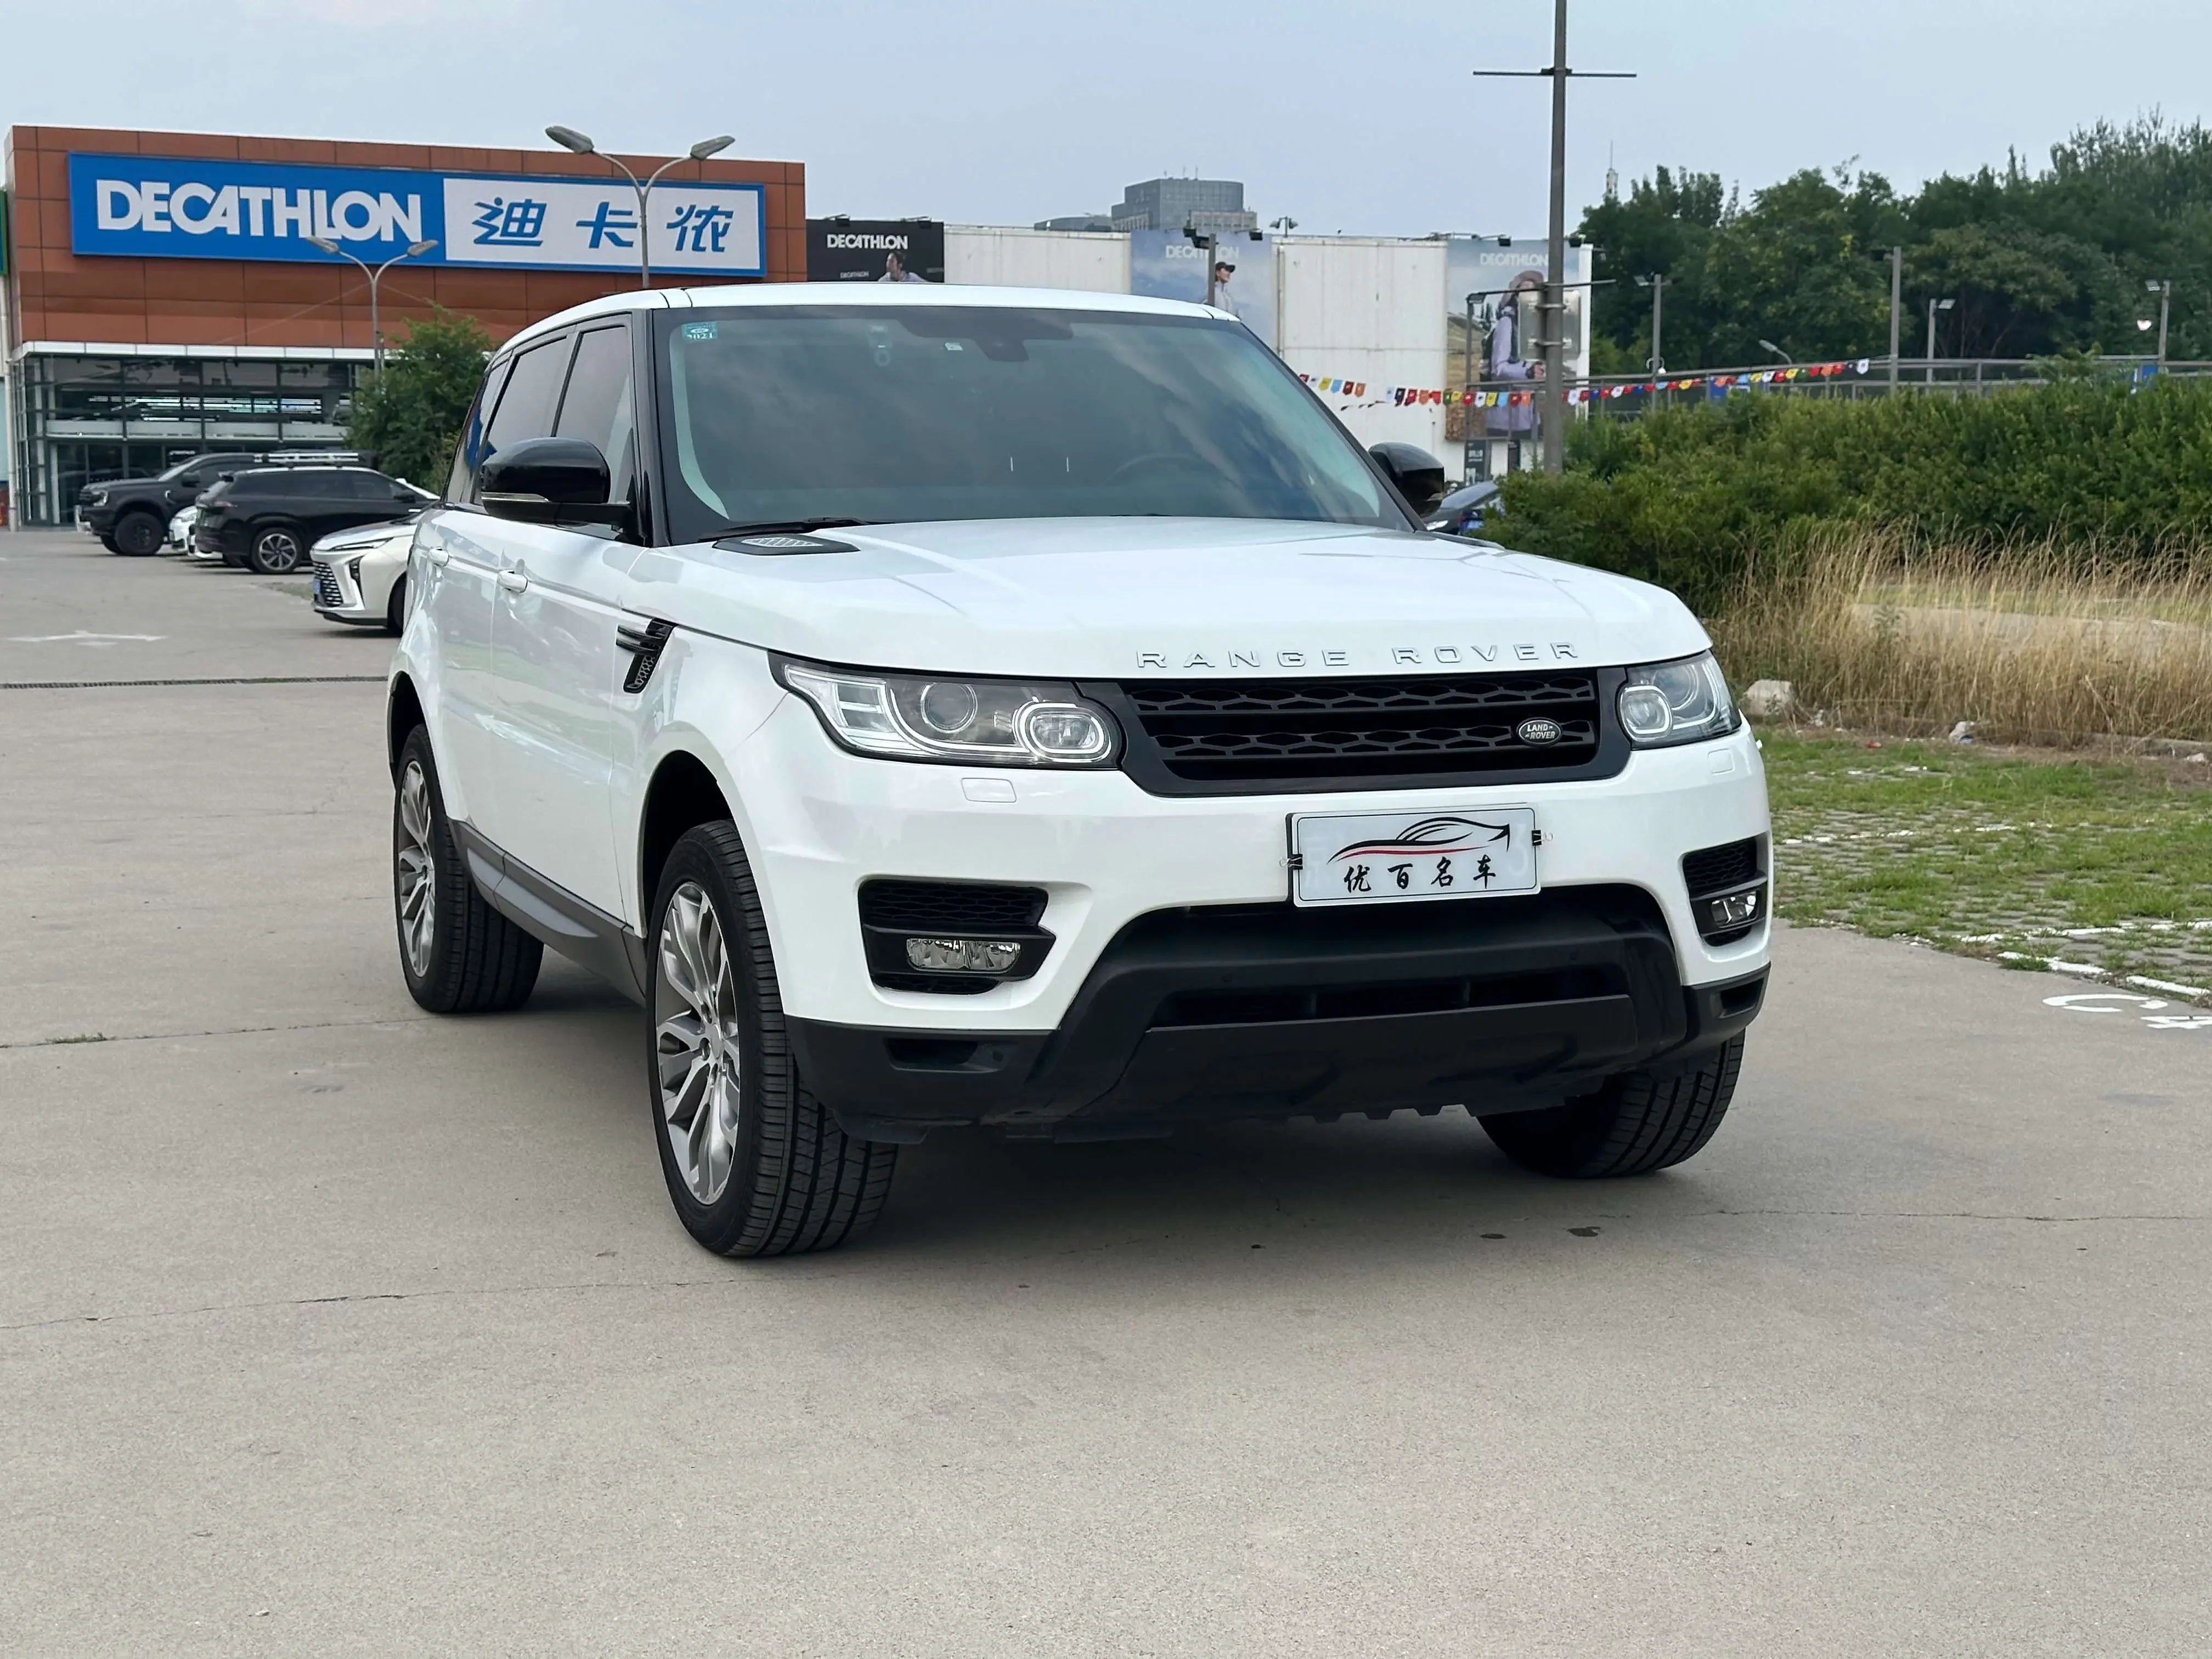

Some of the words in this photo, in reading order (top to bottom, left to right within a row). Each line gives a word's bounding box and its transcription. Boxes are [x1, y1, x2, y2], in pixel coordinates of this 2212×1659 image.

[97, 179, 422, 242] DECATHLON
[472, 197, 733, 252] 迪卡侬
[827, 234, 908, 250] DECATHLON
[1165, 245, 1239, 259] DECATON
[1137, 649, 1350, 668] RANGE
[1392, 642, 1578, 664] ROVER
[1527, 724, 1548, 732] LAND
[1530, 731, 1556, 740] ROVER
[1344, 854, 1496, 893] 优百名车
